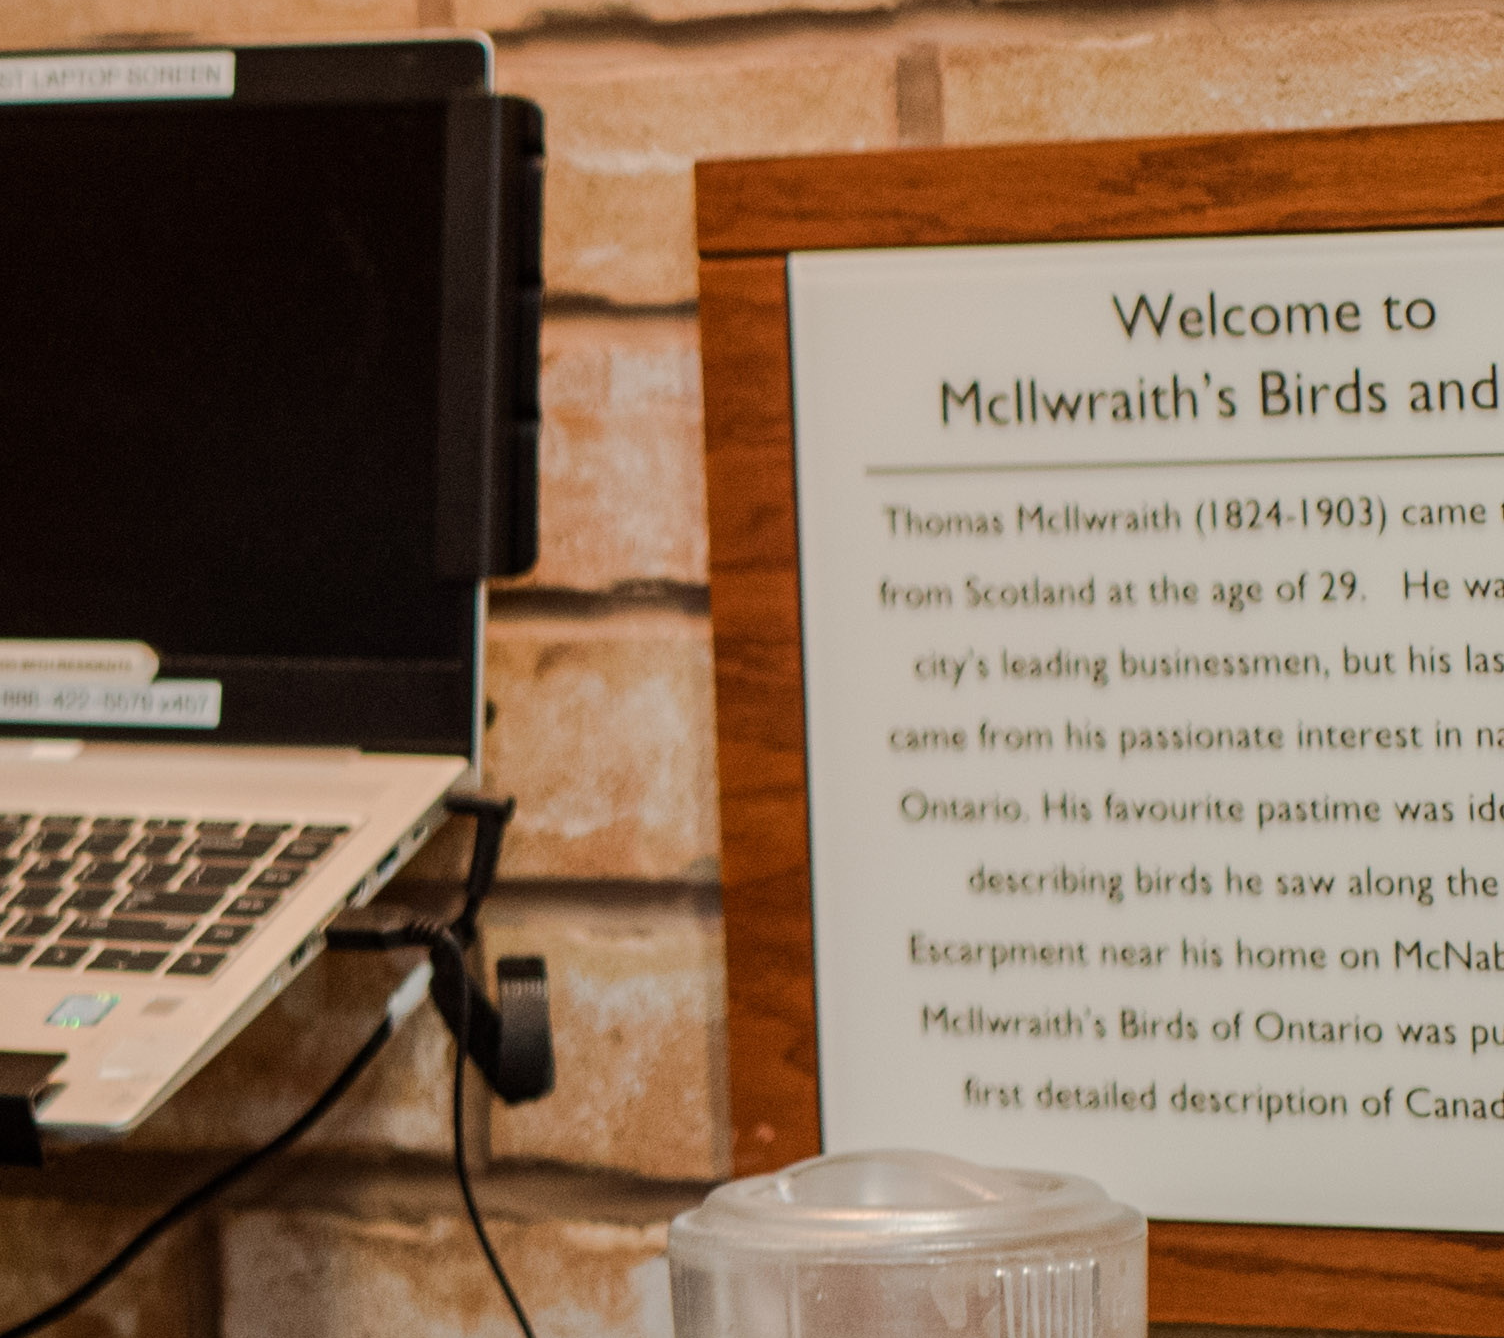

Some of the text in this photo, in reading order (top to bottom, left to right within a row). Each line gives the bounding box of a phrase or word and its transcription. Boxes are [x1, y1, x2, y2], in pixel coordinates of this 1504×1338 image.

[1112, 291, 1436, 339] Welcome to
[1260, 368, 1387, 417] Birds
[1410, 363, 1499, 413] and
[884, 505, 1004, 538] Thomas
[1195, 496, 1387, 534] (1824-1903)
[1402, 504, 1486, 526] came
[879, 579, 953, 609] from
[965, 577, 1096, 608] Scotland
[1109, 582, 1136, 606] at
[1149, 575, 1198, 605] the
[1212, 582, 1262, 613] age
[1276, 572, 1307, 602] of
[1321, 571, 1365, 602] 29.
[1403, 570, 1449, 600] He
[914, 650, 989, 688] city's
[1002, 649, 1109, 688] leading
[1120, 649, 1329, 678] businessmen,
[1343, 646, 1395, 675] but
[1408, 645, 1452, 675] his
[889, 729, 966, 752] came
[978, 721, 1053, 751] from
[1065, 721, 1107, 751] his
[1119, 726, 1283, 758] passionate
[1298, 726, 1422, 749] interest
[1435, 728, 1462, 748] in
[899, 790, 1029, 824] Ontario.
[1043, 793, 1092, 823] His
[1104, 793, 1244, 823] favourite
[1257, 797, 1380, 831] pastime
[1395, 802, 1454, 823] was
[968, 865, 1498, 907] describing birds he saw along the
[909, 933, 1087, 972] Escarpment
[1100, 946, 1167, 967] near
[1181, 938, 1223, 969] his
[1236, 939, 1326, 970] home
[1339, 949, 1380, 970] on
[1120, 1008, 1198, 1041] Birds
[1212, 1011, 1242, 1041] of
[1254, 1011, 1383, 1044] Ontario
[1397, 1024, 1457, 1046] was
[964, 1077, 1022, 1108] first
[1036, 1080, 1157, 1112] detailed
[1170, 1083, 1348, 1123] description
[1361, 1087, 1393, 1117] of
